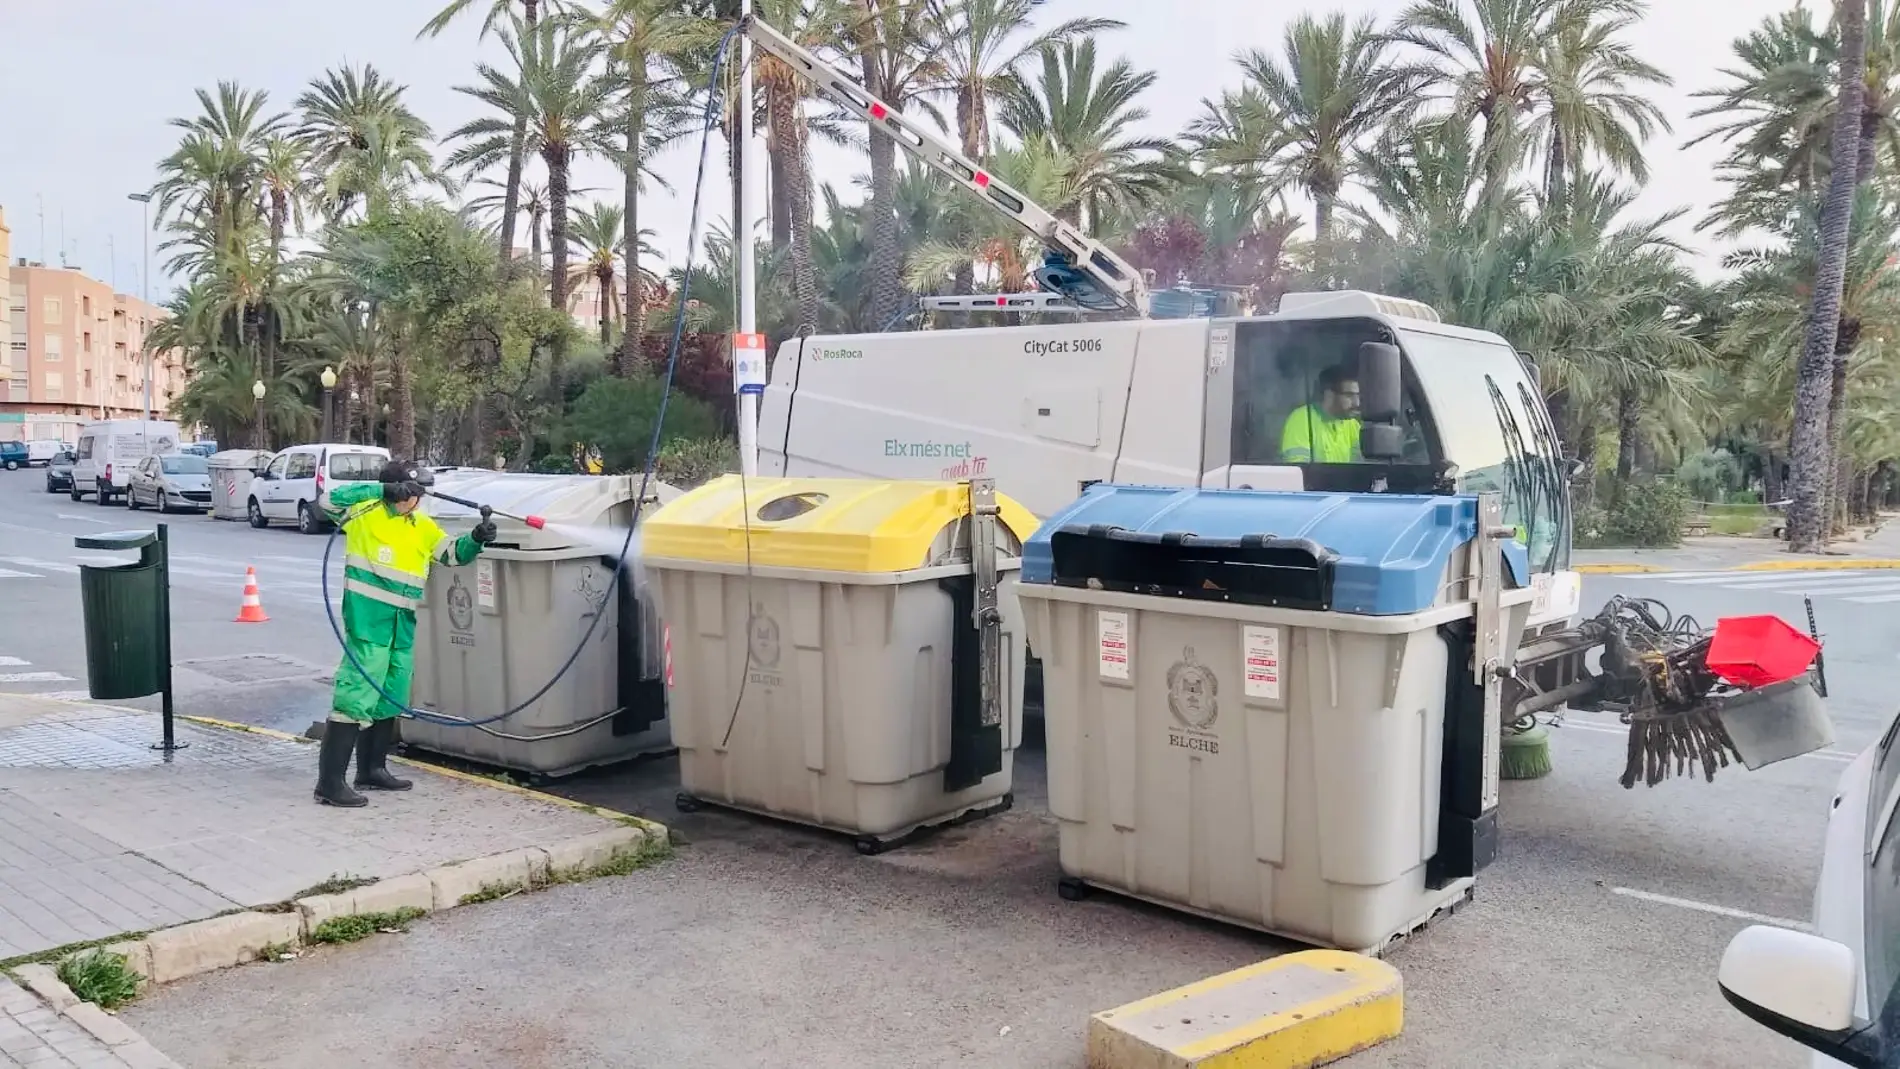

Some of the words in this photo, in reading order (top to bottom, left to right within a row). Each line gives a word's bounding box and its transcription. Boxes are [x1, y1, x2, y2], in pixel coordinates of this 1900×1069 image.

[823, 349, 863, 360] RosRoca
[1024, 339, 1069, 357] CityCat
[1072, 338, 1102, 353] 5006
[884, 439, 907, 457] Elx
[910, 440, 941, 458] més
[944, 441, 972, 458] net
[1168, 734, 1219, 755] ELCHE
